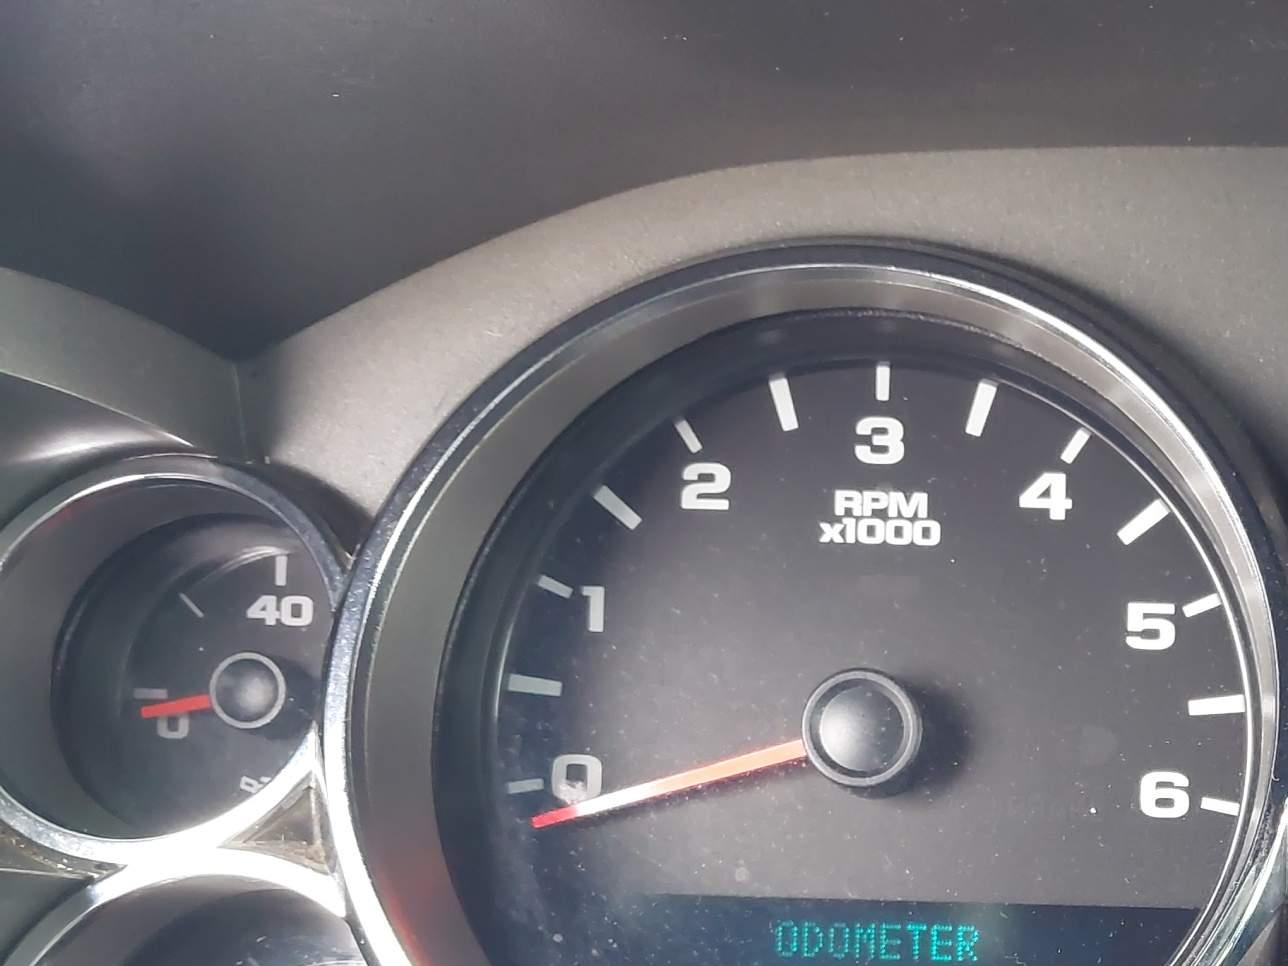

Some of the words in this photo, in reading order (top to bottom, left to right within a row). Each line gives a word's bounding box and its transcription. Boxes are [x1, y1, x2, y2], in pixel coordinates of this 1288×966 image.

[853, 416, 905, 465] 3
[680, 462, 732, 510] 2
[834, 489, 929, 518] RPM
[1018, 472, 1073, 521] 4
[818, 517, 941, 547] x1000
[246, 594, 314, 628] 40
[581, 584, 606, 633] 1
[1125, 601, 1176, 651] 5
[551, 753, 602, 804] 0
[1139, 771, 1190, 819] 6
[774, 919, 981, 962] ODOMETER
